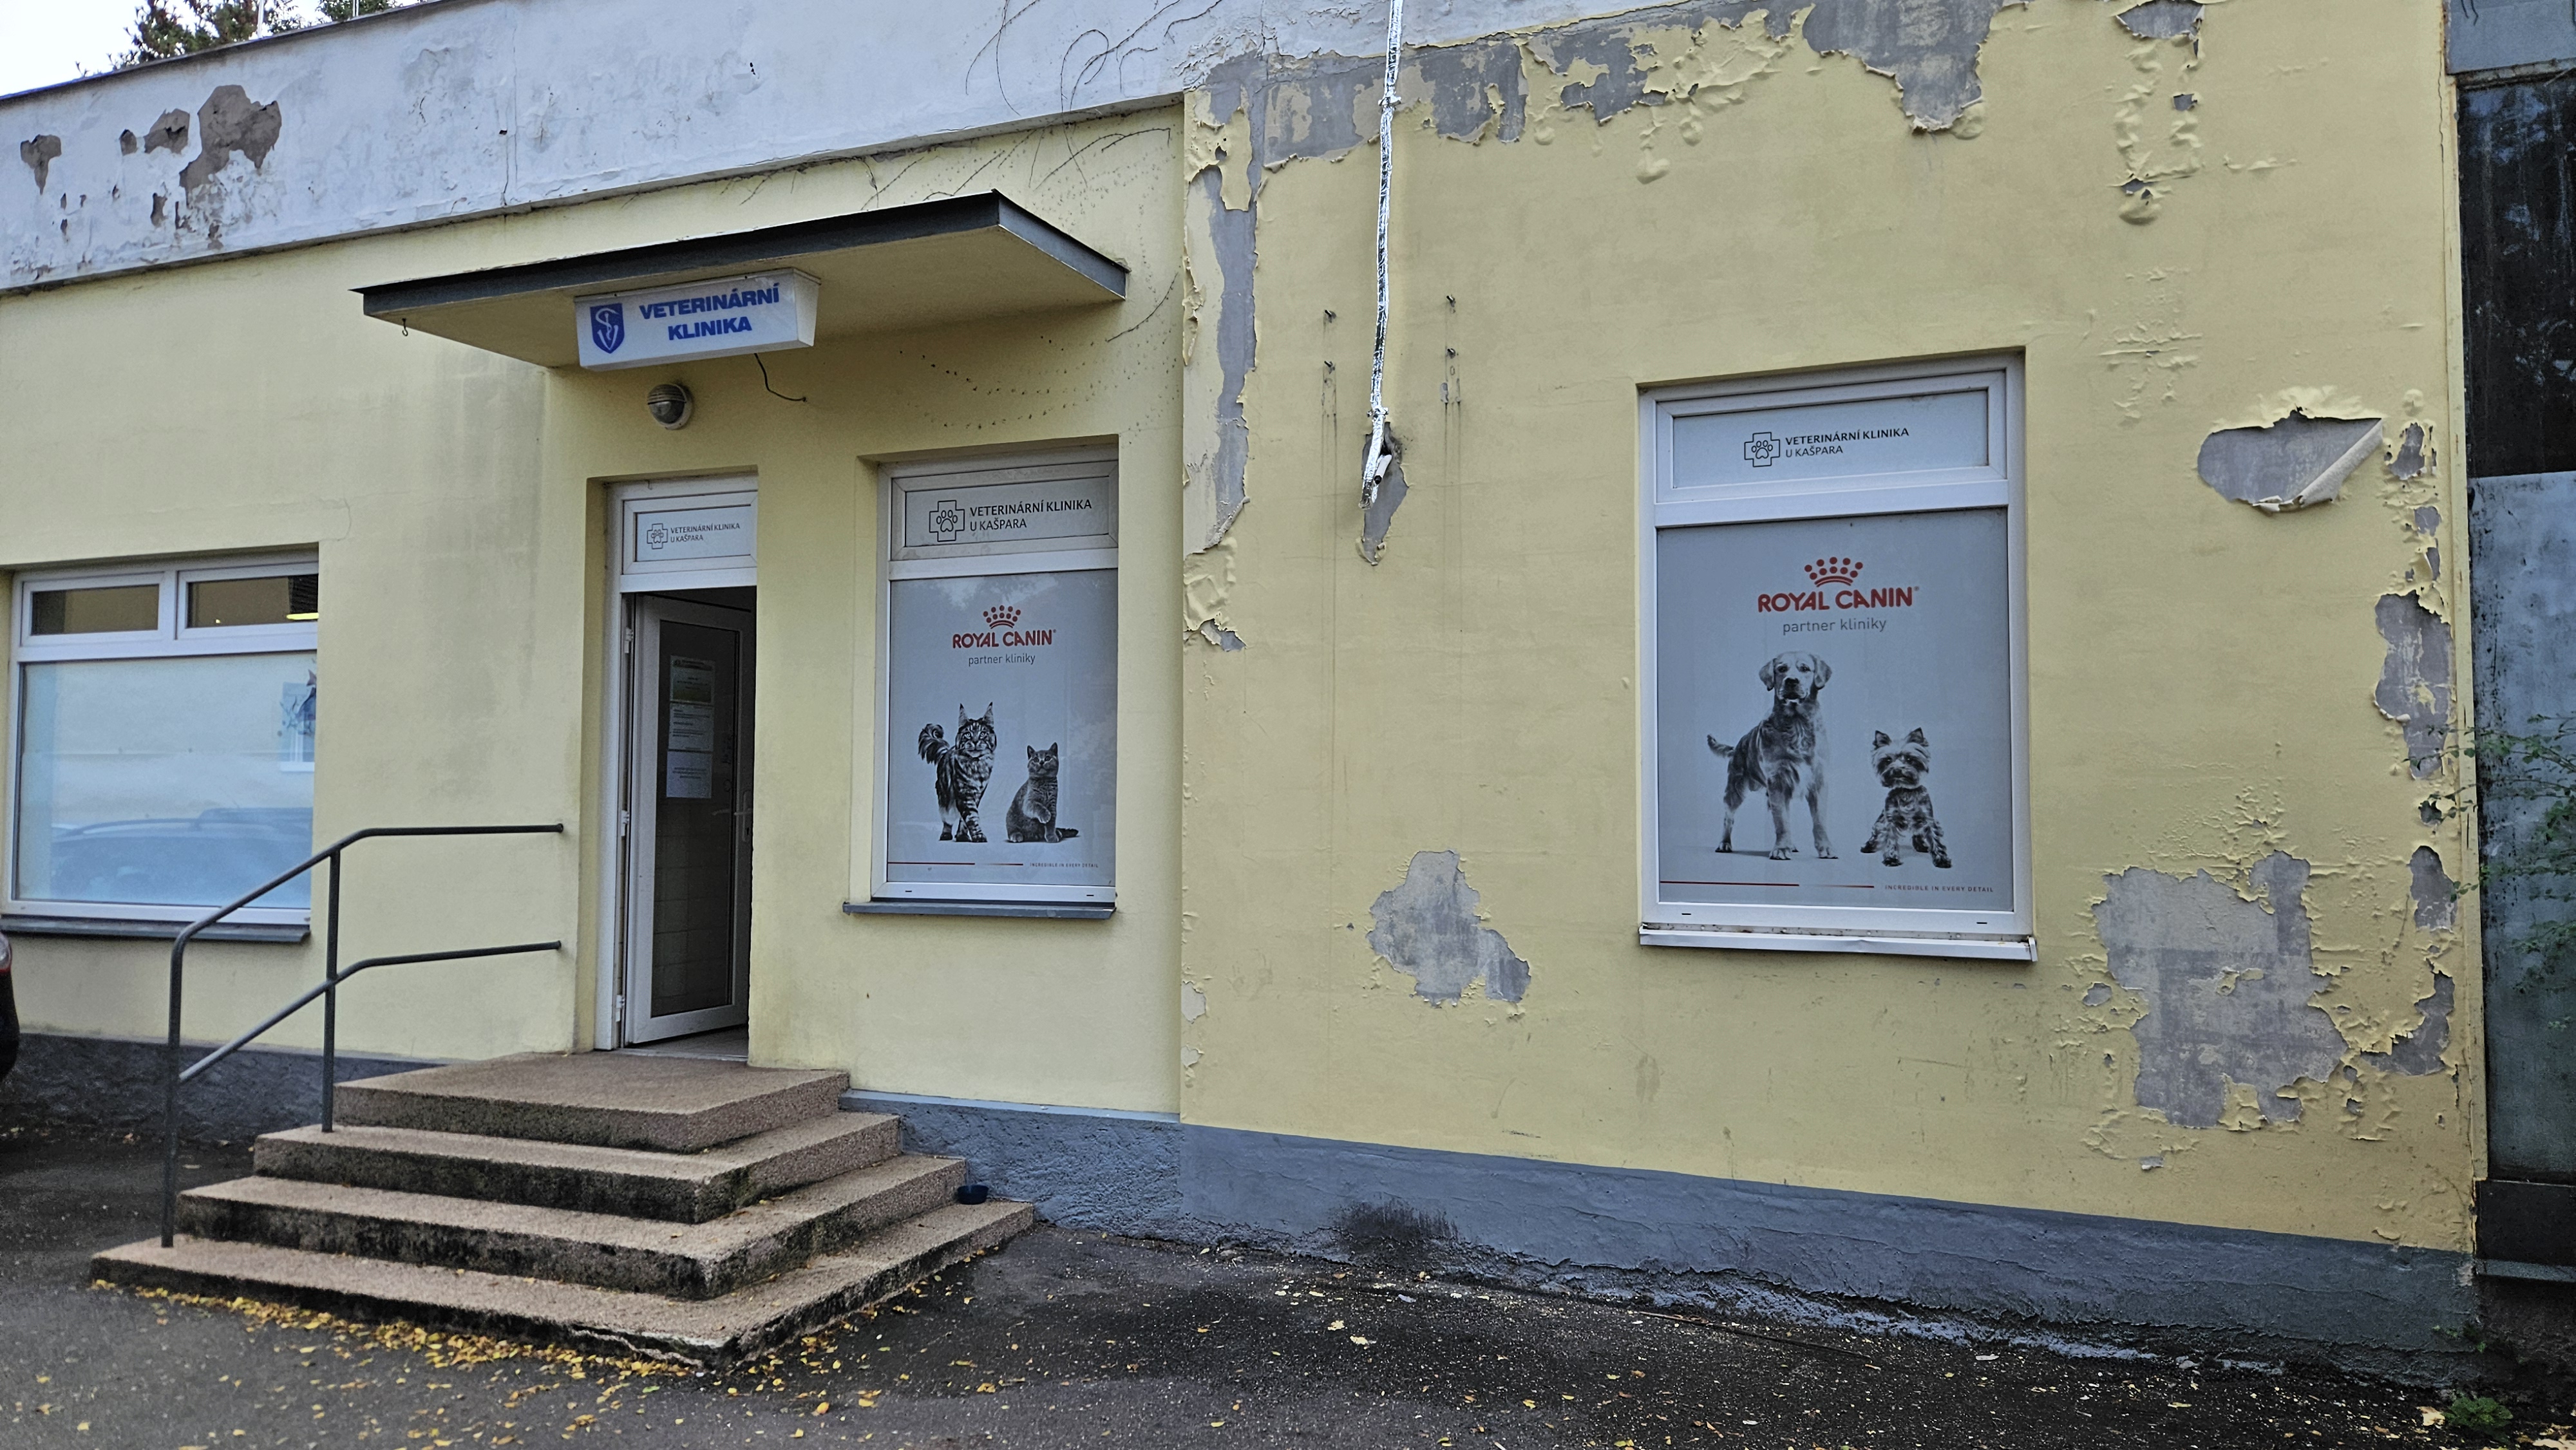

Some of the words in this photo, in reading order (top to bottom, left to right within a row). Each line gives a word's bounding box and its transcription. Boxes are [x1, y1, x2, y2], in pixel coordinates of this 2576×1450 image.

[639, 283, 780, 319] VETERINÁRNÍ
[668, 316, 752, 341] KLINIKA
[1785, 429, 1861, 445] VETERINÁRNÍ
[1863, 428, 1909, 440] KLINIKA
[1786, 449, 1792, 458] U
[1795, 446, 1843, 457] KAŠPARA
[970, 500, 1044, 516] VETERINÁRNÍ
[1046, 499, 1092, 512] KLINIKA
[670, 523, 713, 533] VETERINÁRNÍ
[970, 522, 977, 531] U
[980, 518, 1027, 531] KAŠPARA
[676, 534, 703, 542] KAŠPARA
[1757, 591, 1830, 612] ROYAL
[1783, 621, 1835, 636] partner
[1841, 617, 1886, 632] kliniky
[952, 632, 999, 648] ROYAL
[969, 655, 1003, 667] partner
[1005, 653, 1036, 665] kliniky
